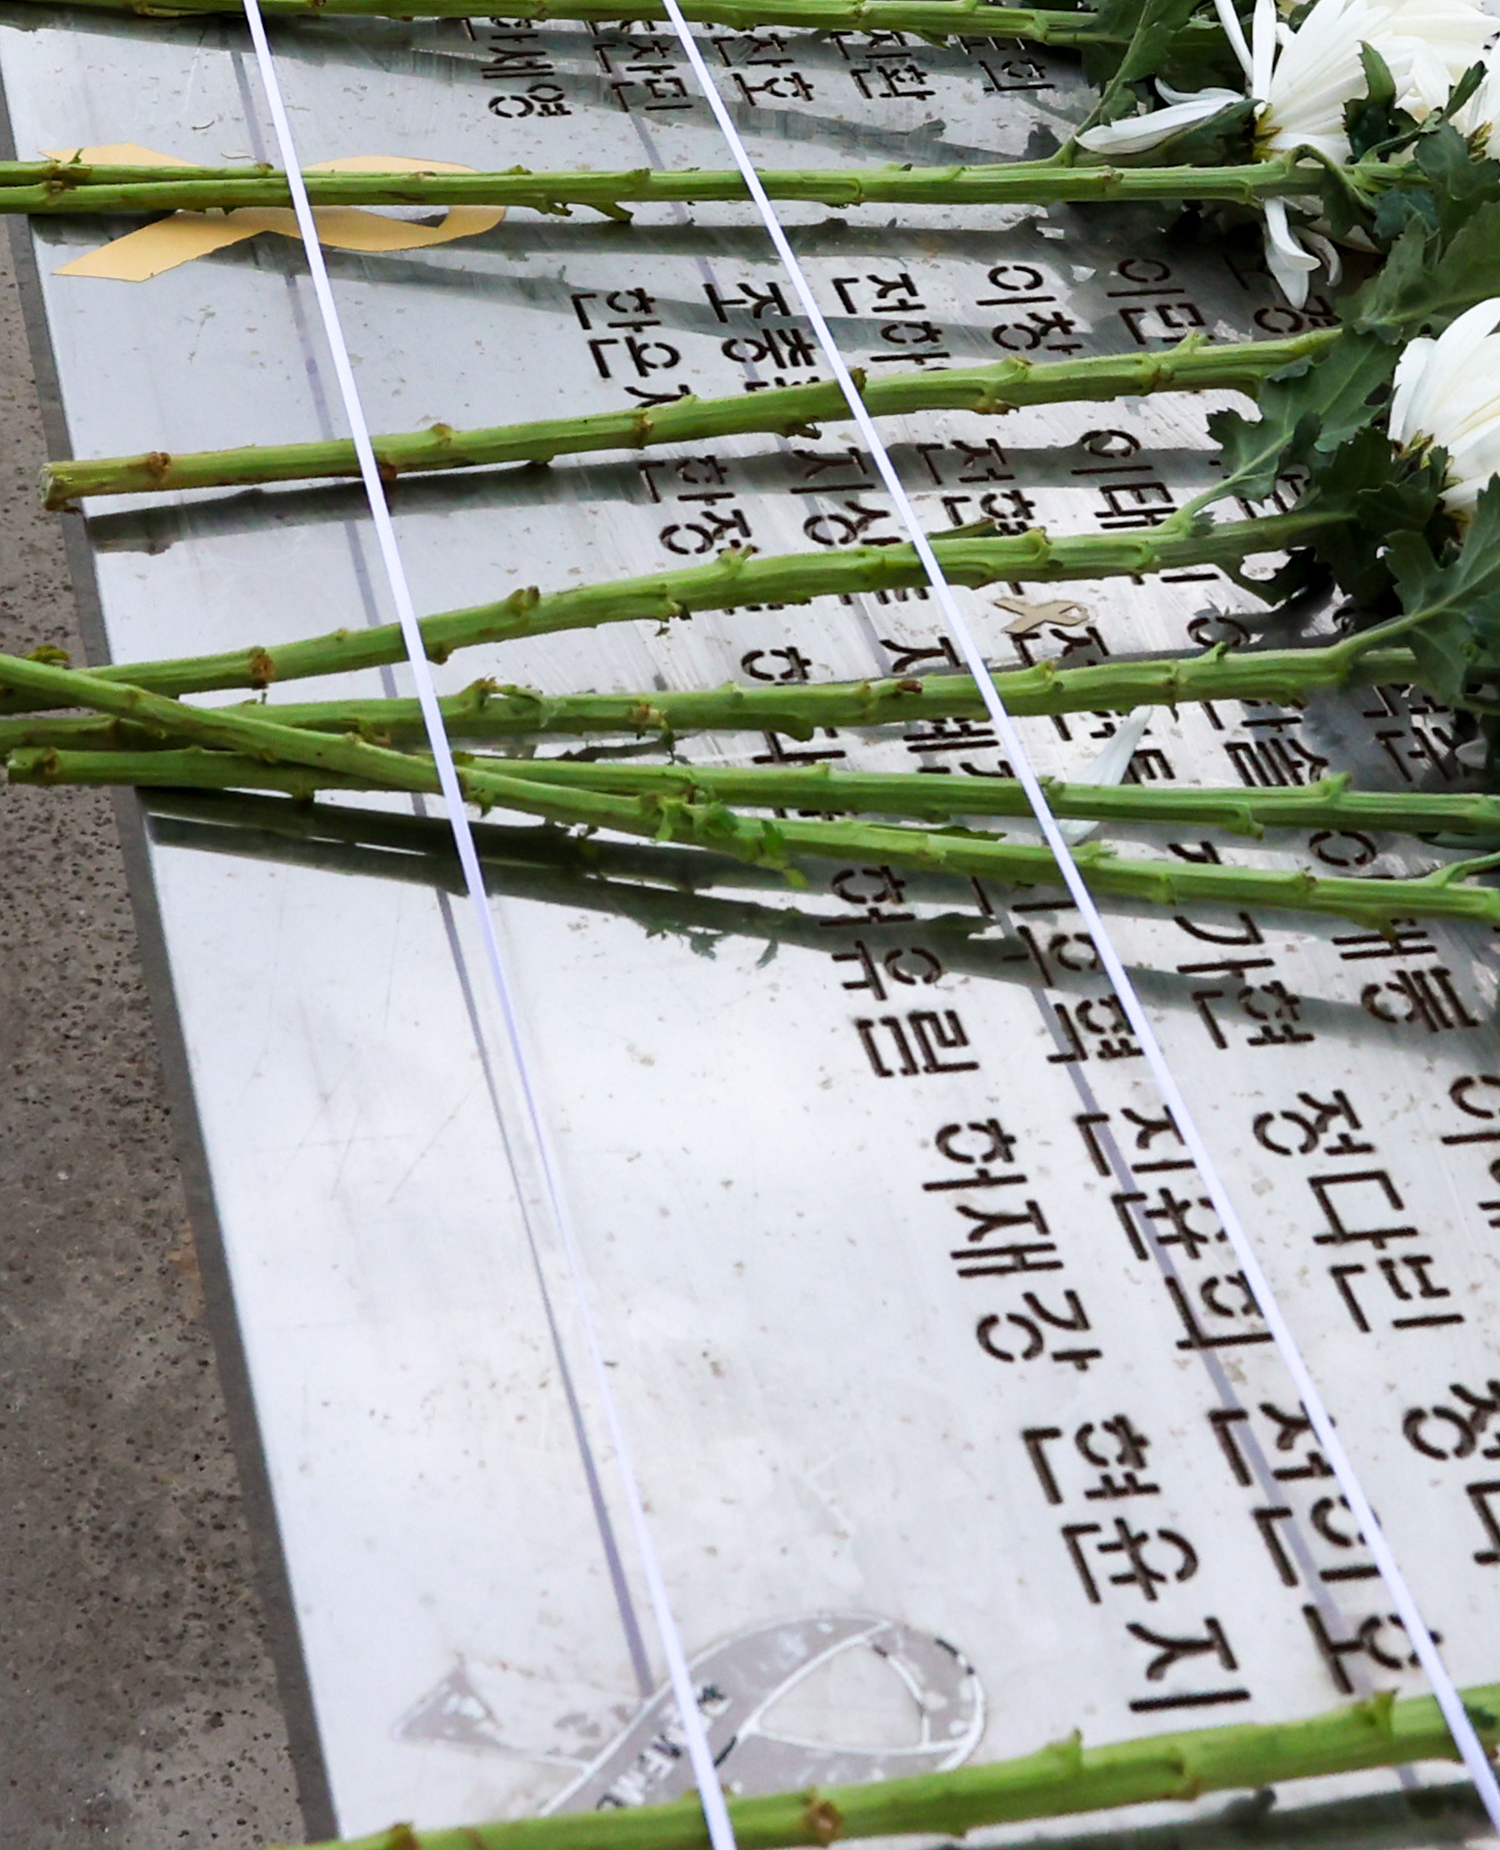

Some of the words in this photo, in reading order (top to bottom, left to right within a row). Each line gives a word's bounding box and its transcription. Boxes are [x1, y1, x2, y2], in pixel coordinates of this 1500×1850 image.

[803, 863, 980, 1078] 허유림
[921, 1117, 1103, 1372] 허재강
[1019, 1413, 1251, 1713] 현윤지
[1065, 1102, 1289, 1354] 진윤희
[1205, 1396, 1469, 1698] 천인호
[1251, 1088, 1465, 1333] 정다빈
